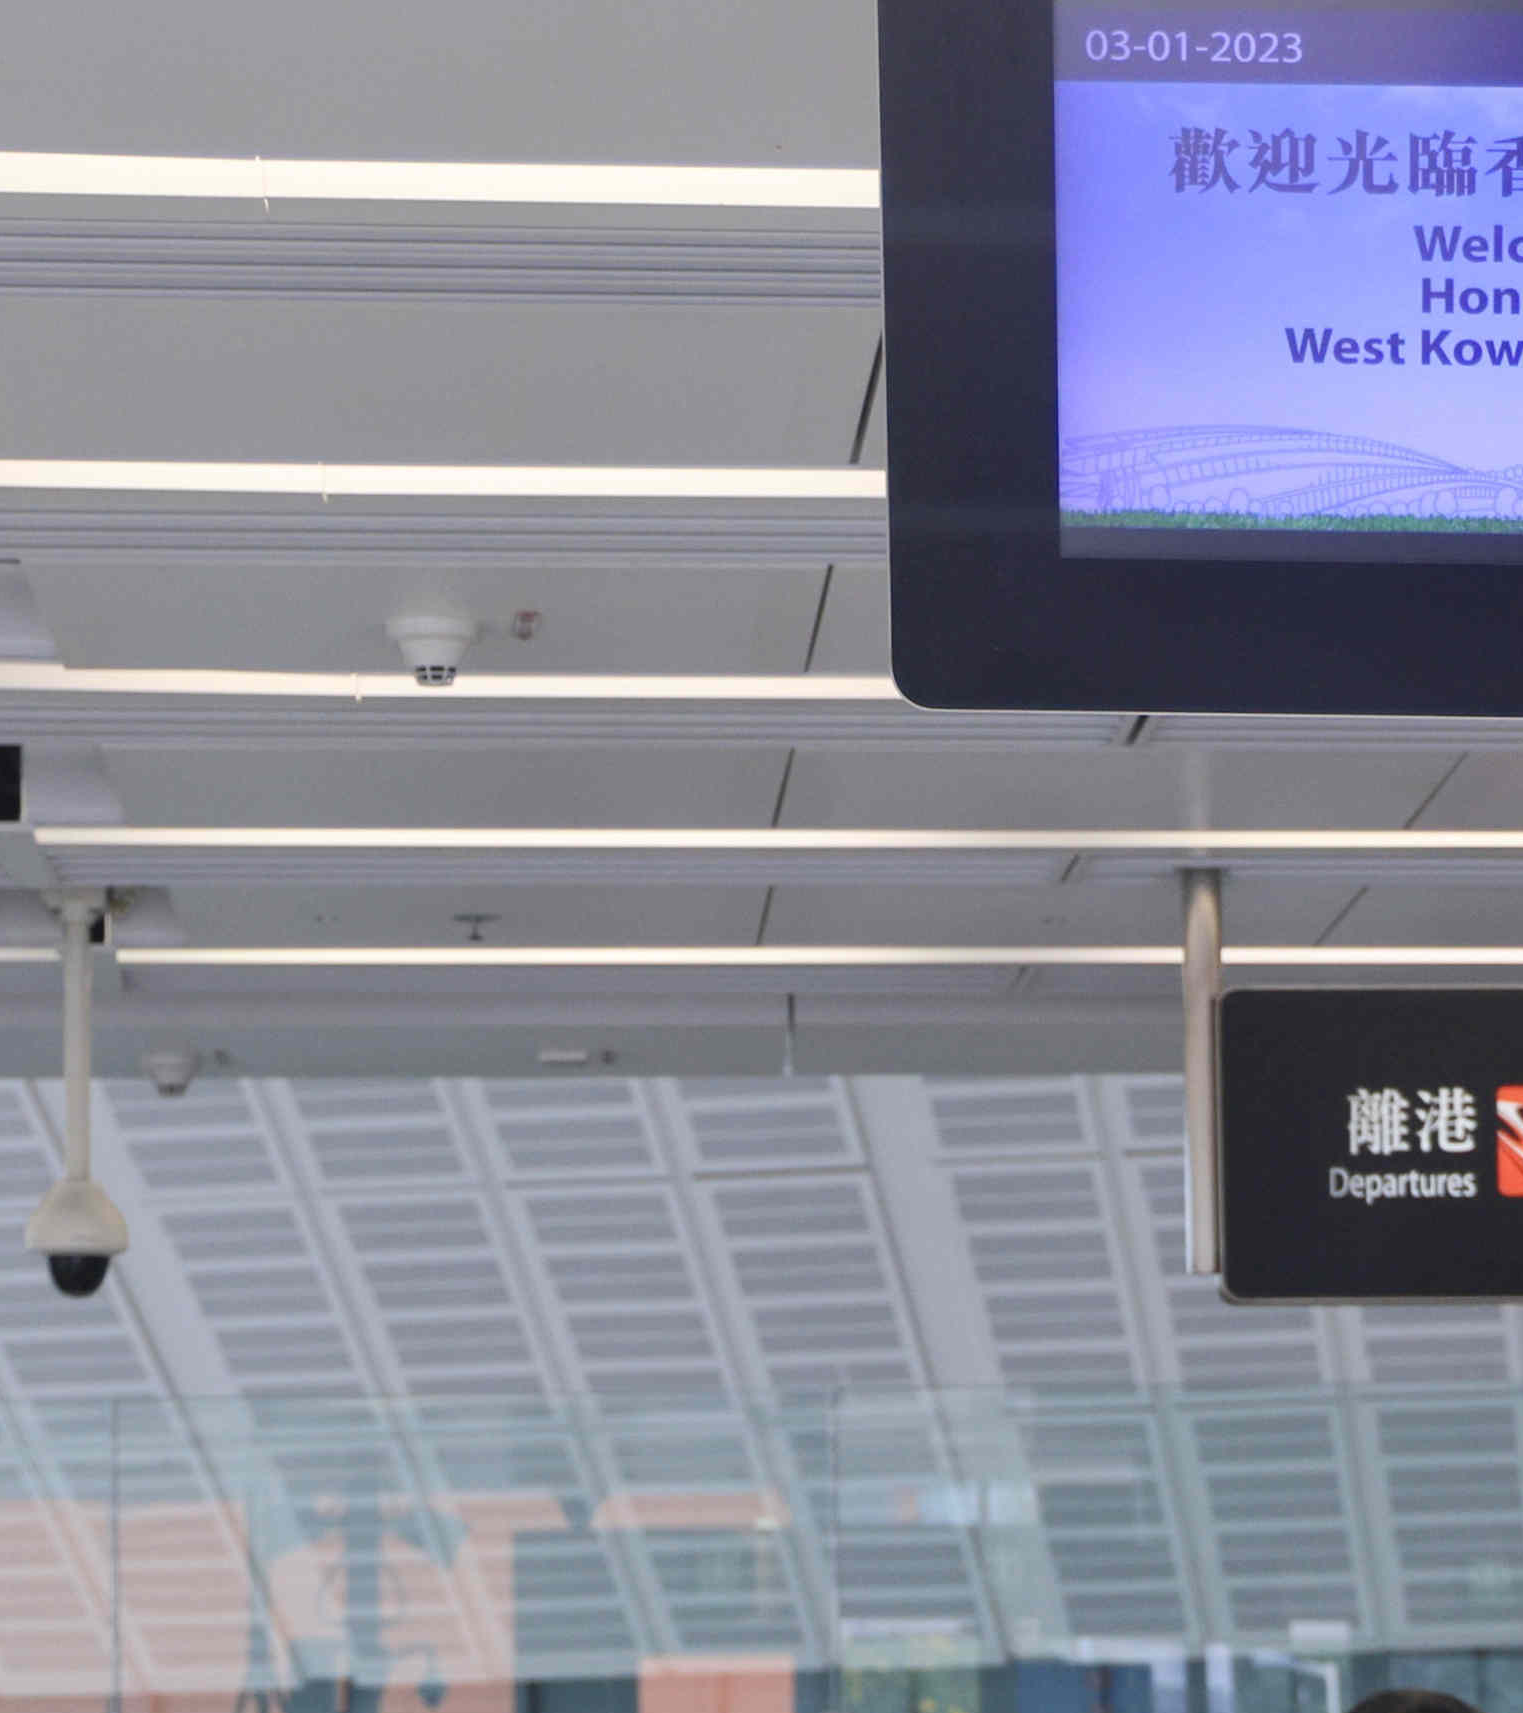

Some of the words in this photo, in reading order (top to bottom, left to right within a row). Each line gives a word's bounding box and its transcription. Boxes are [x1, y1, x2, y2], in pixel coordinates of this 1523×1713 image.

[1084, 30, 1303, 64] 03-01-2023
[1284, 327, 1406, 365] West
[1347, 1087, 1477, 1156] 離港
[1329, 1166, 1477, 1205] Departures
